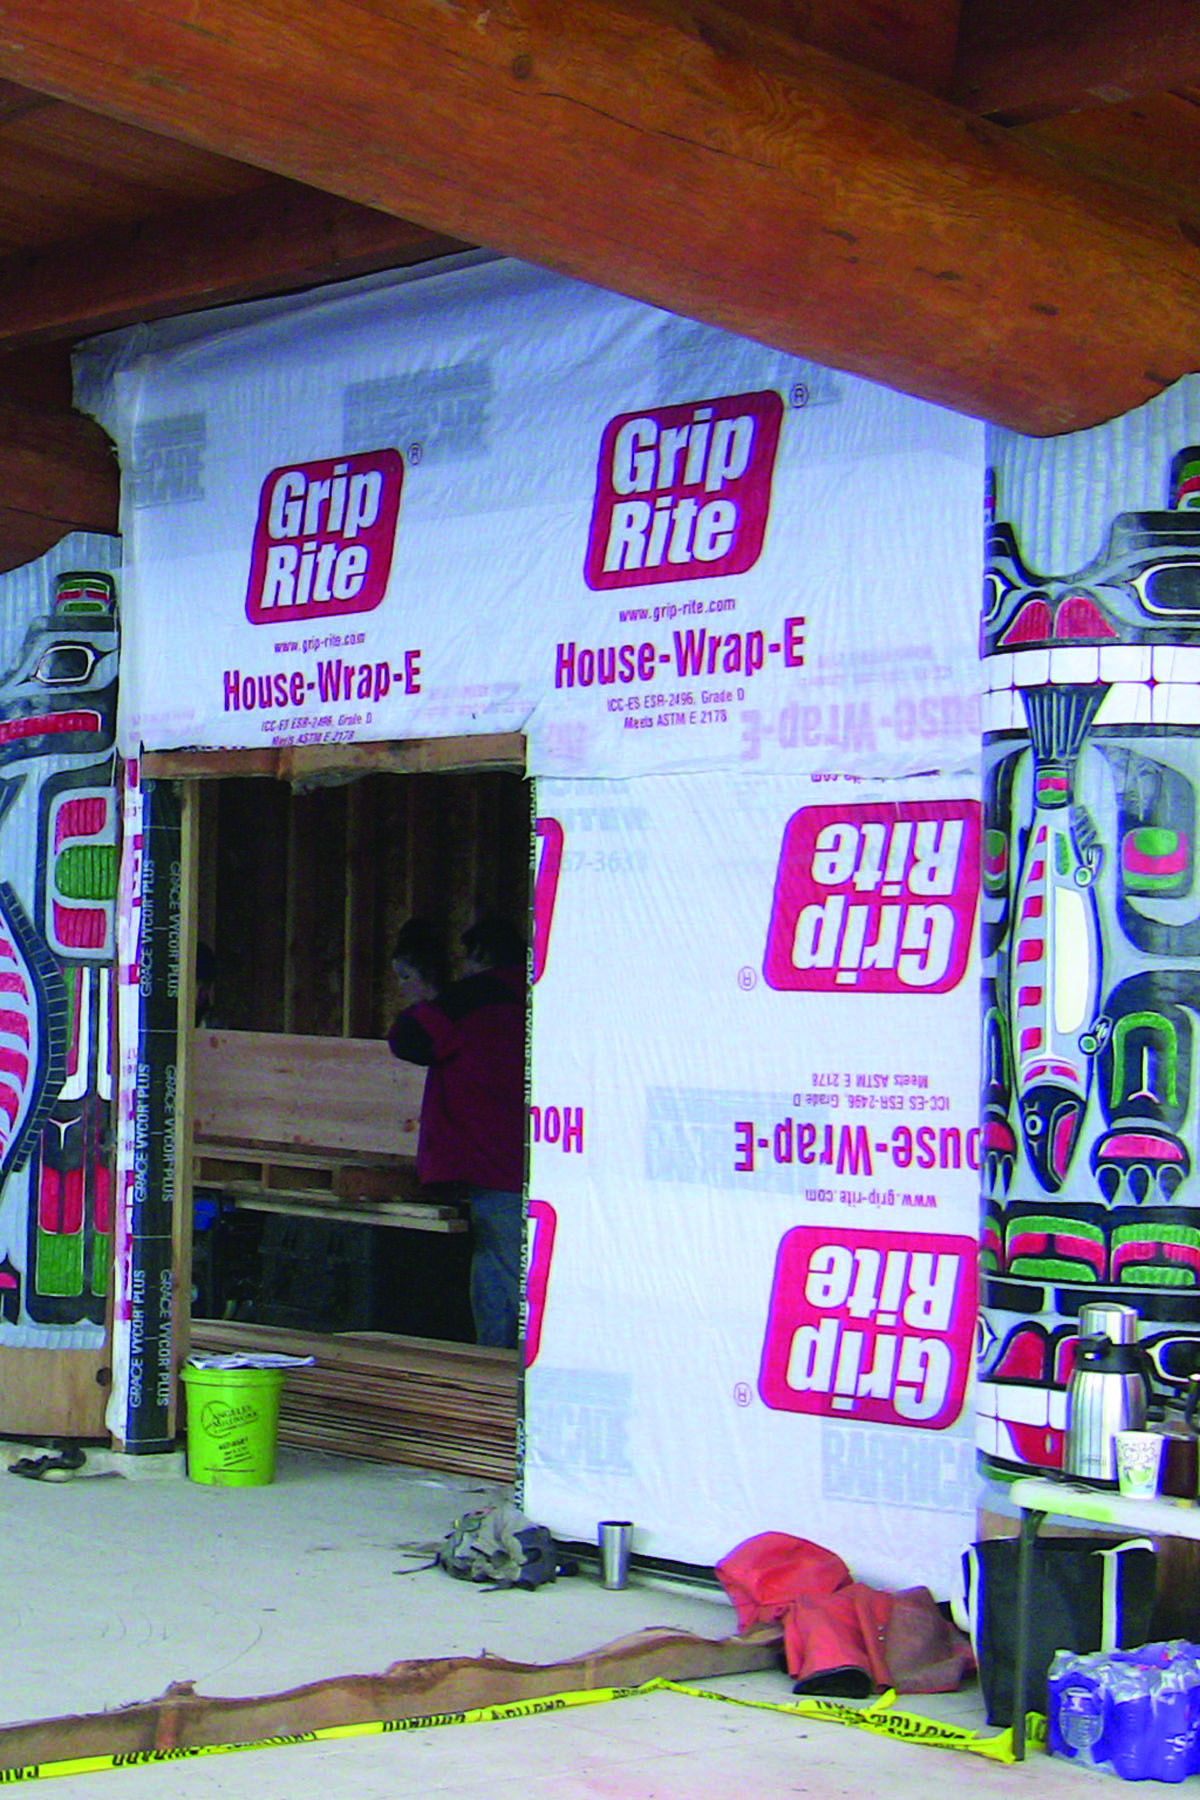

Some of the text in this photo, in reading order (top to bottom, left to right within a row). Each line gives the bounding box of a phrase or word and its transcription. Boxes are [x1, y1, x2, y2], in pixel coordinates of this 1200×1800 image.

[611, 407, 756, 495] Grip
[267, 463, 383, 540] Grip
[602, 494, 739, 574] Rite
[260, 541, 369, 609] Rite
[618, 598, 737, 622] www.grip-rite.com
[223, 649, 422, 712] House-Wrap-E
[555, 616, 806, 689] House-Wrap-E
[810, 819, 964, 897] Rite
[790, 895, 956, 987] Grip
[137, 1063, 150, 1098] PLUS
[793, 1093, 802, 1107] D
[803, 1093, 840, 1108] Grade
[856, 1073, 889, 1089] ASTM
[804, 1187, 938, 1209] www.grip-rite.com
[133, 1270, 146, 1304] PLUS
[803, 1243, 960, 1332] Rite
[157, 1372, 170, 1406] PLUS
[785, 1318, 952, 1421] Grip
